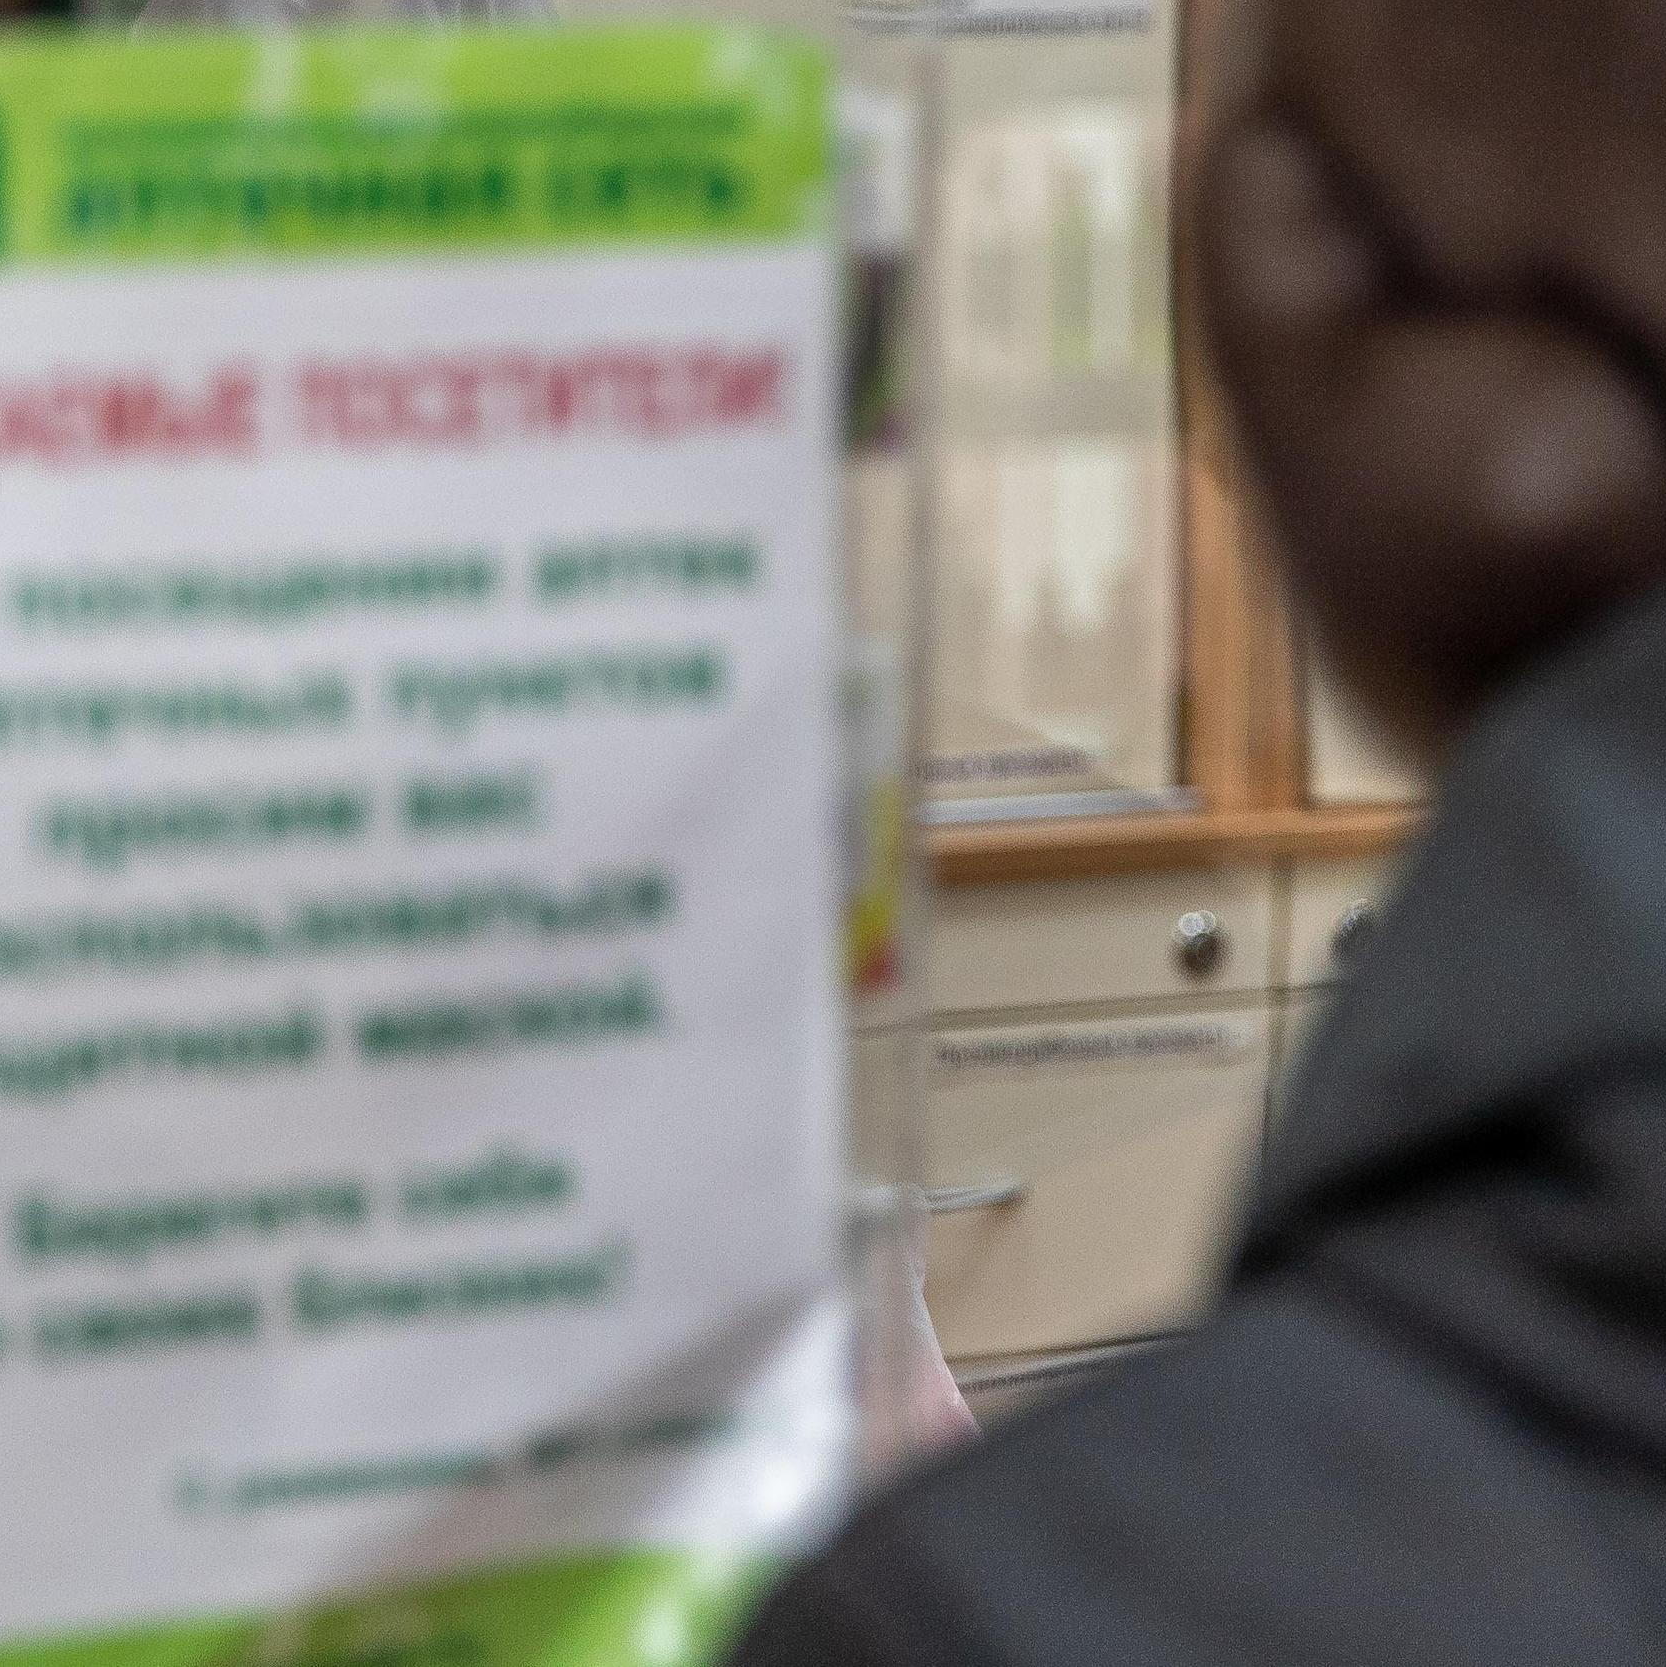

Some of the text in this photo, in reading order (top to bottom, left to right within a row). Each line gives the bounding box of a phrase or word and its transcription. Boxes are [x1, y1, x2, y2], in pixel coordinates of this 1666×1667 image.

[13, 552, 501, 628] посещении
[535, 538, 759, 602] аптек
[39, 786, 370, 870] просим
[14, 1150, 573, 1264] Берегите себя
[35, 1292, 259, 1356] своих
